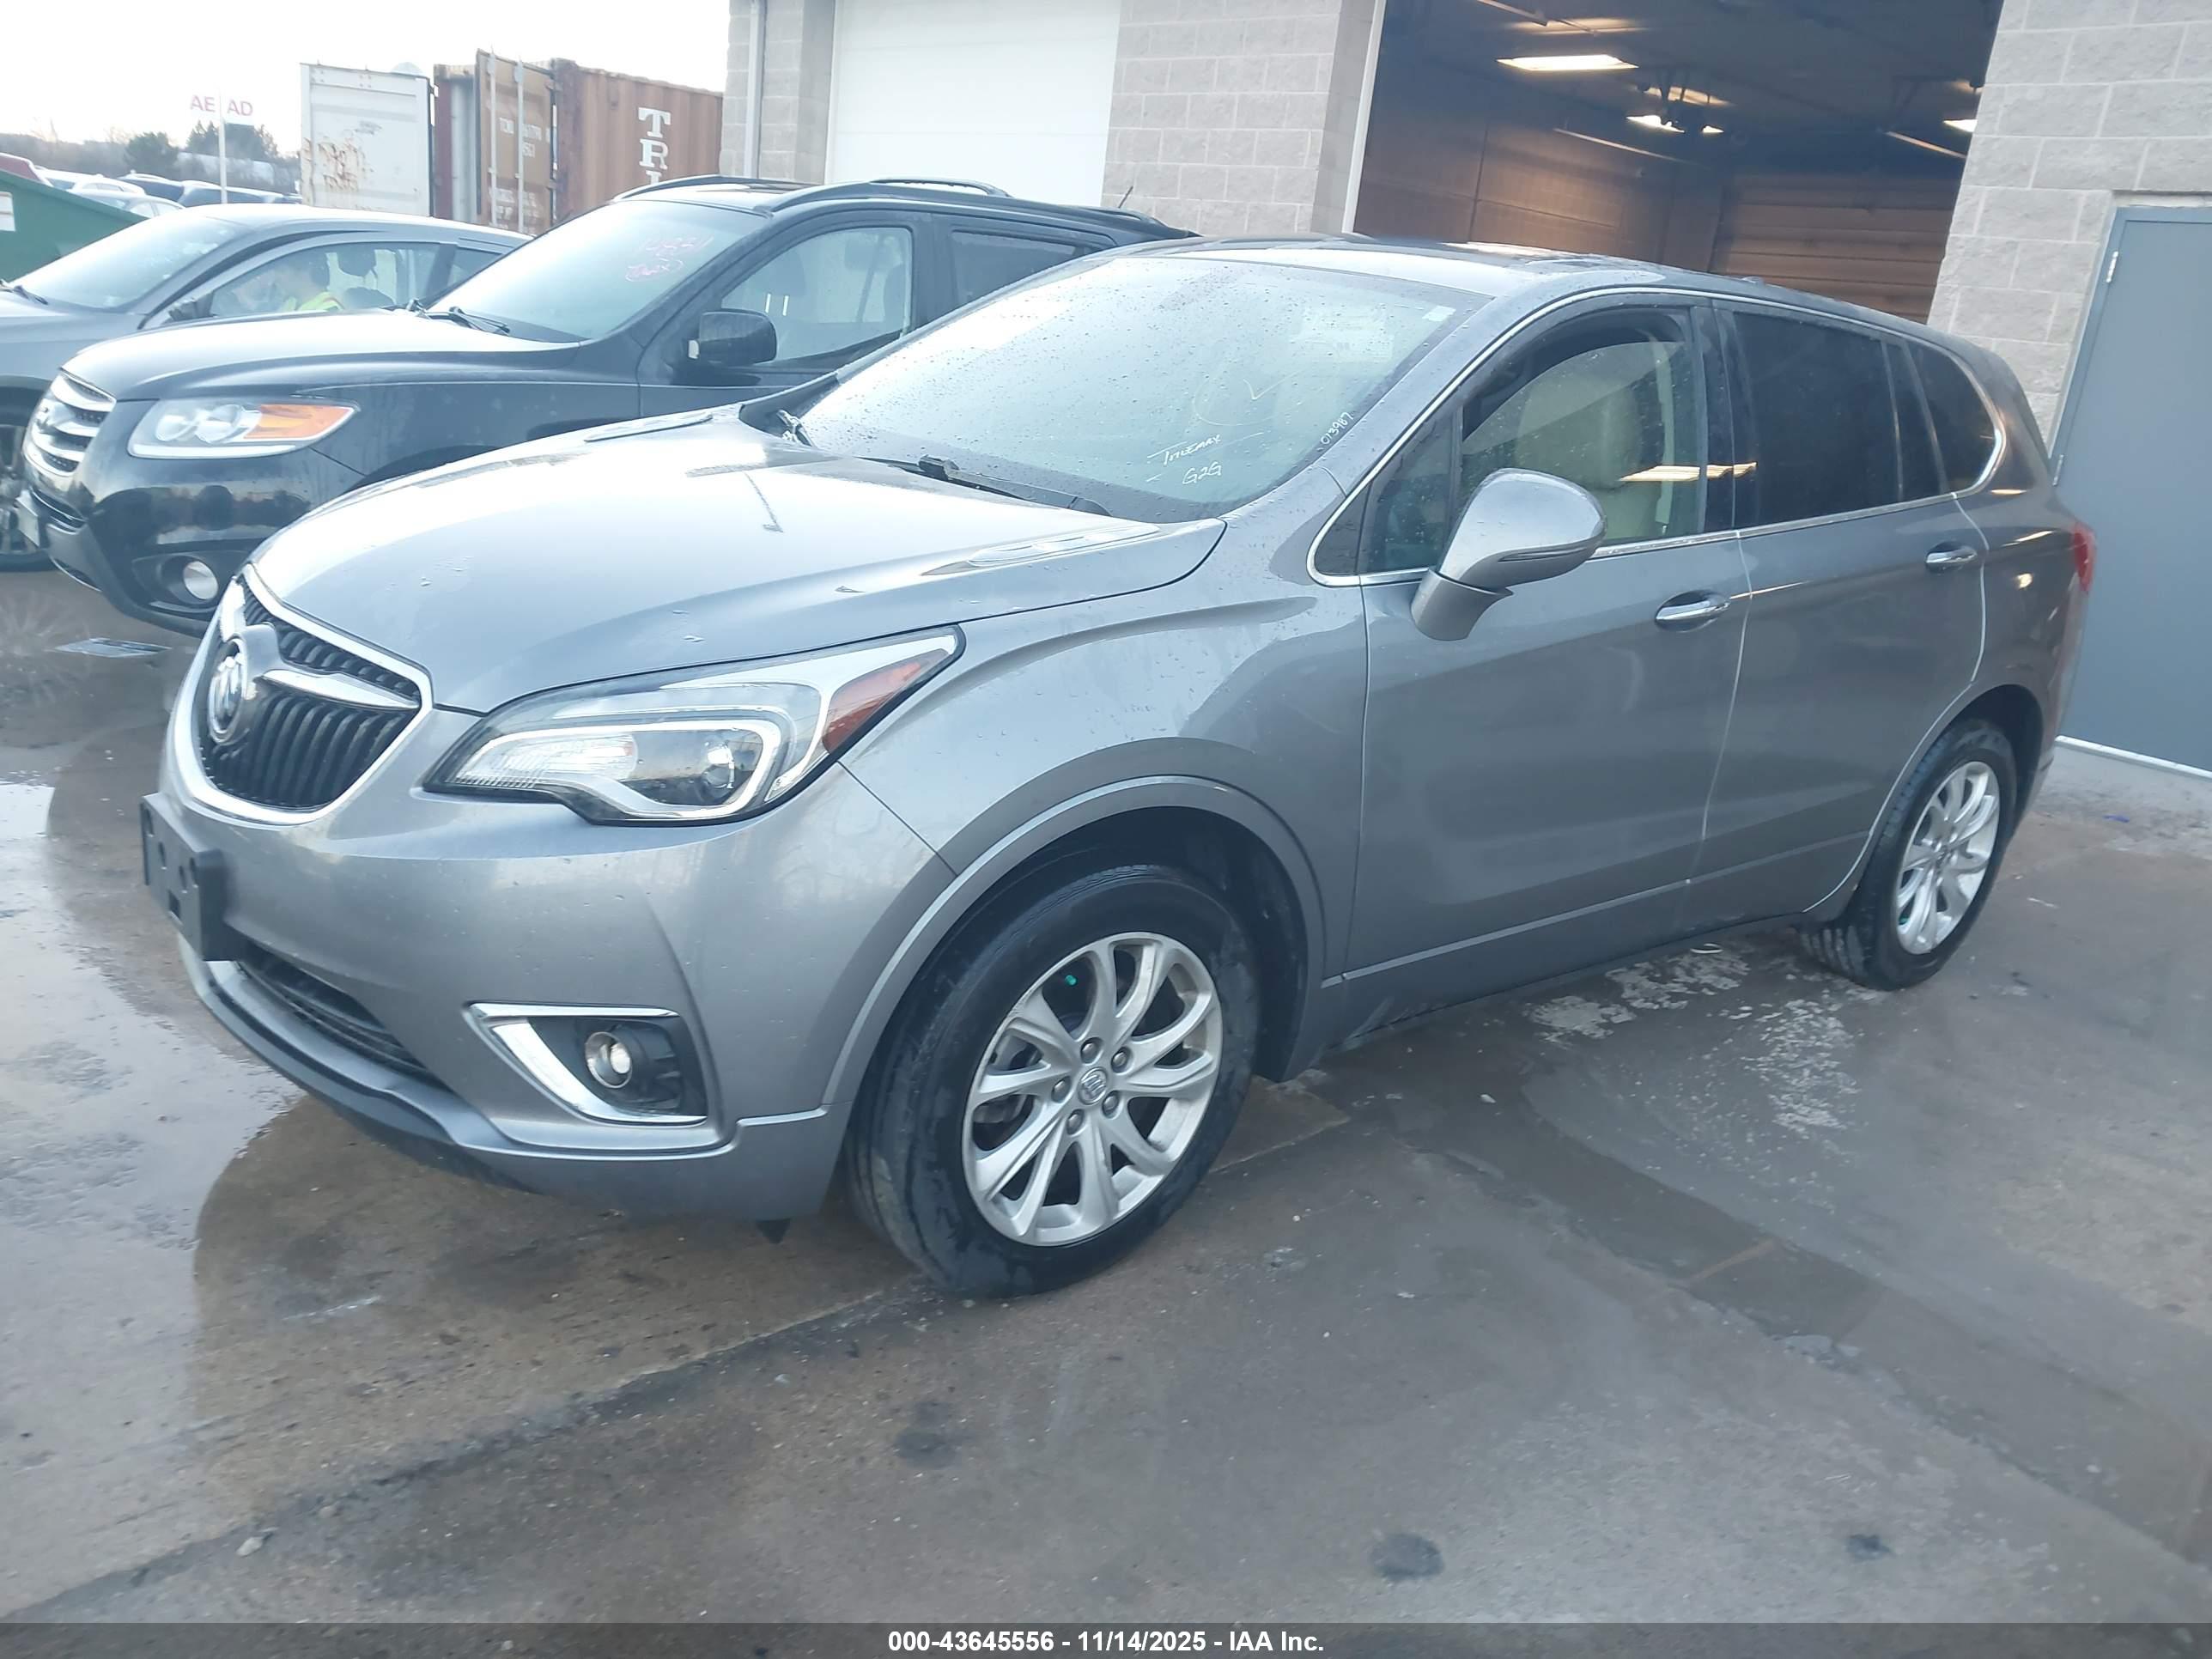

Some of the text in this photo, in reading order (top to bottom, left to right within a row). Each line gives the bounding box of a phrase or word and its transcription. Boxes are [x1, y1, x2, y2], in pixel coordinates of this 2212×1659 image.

[190, 94, 216, 112] AE
[227, 99, 253, 116] AD
[1182, 461, 1221, 484] G2G
